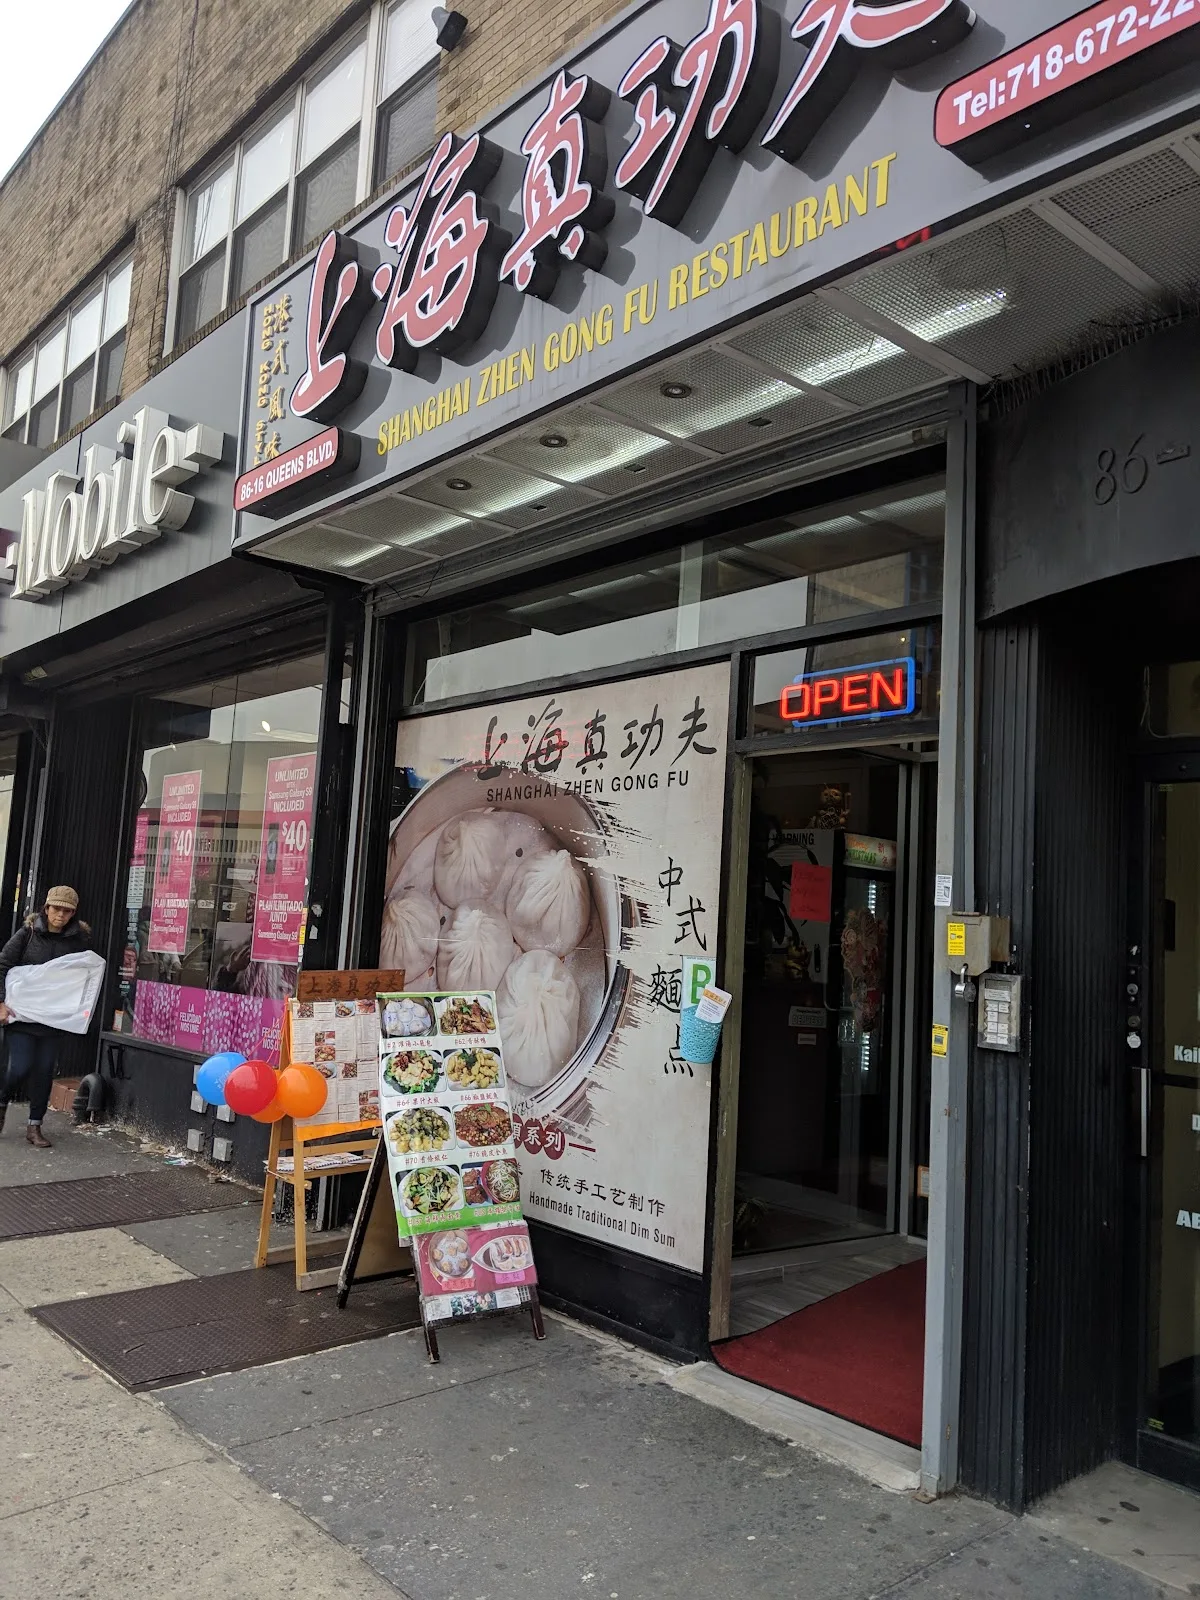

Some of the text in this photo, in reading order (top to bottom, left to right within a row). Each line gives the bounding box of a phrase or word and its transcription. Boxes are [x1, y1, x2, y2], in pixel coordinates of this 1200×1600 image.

[376, 151, 897, 456] SHANGHAI ZHEN GONG FU RESTAURANT
[261, 303, 276, 351] HONG
[256, 360, 272, 409] KONG
[240, 439, 335, 502] 86-16 QUEENS BLVD.
[9, 404, 199, 600] Mobile
[780, 667, 904, 720] OPEN
[476, 694, 718, 781] 上海真功夫
[275, 767, 309, 782] UNLIMITED
[486, 769, 690, 803] SHANGHAI ZHEN GONG FU
[268, 790, 289, 800] Samsung
[273, 799, 305, 813] INCLUDED
[174, 828, 192, 857] $40
[281, 819, 307, 852] $40
[269, 911, 288, 923] JUNTO
[690, 963, 712, 1005] B
[1173, 1044, 1200, 1064] Kai
[405, 1157, 418, 1165] #70
[468, 1150, 480, 1158] #76
[539, 1167, 666, 1219] 传统手工艺制作
[528, 1189, 574, 1218] Handmade
[576, 1204, 628, 1233] Traditional
[630, 1218, 651, 1239] Dim
[653, 1225, 676, 1249] Sum
